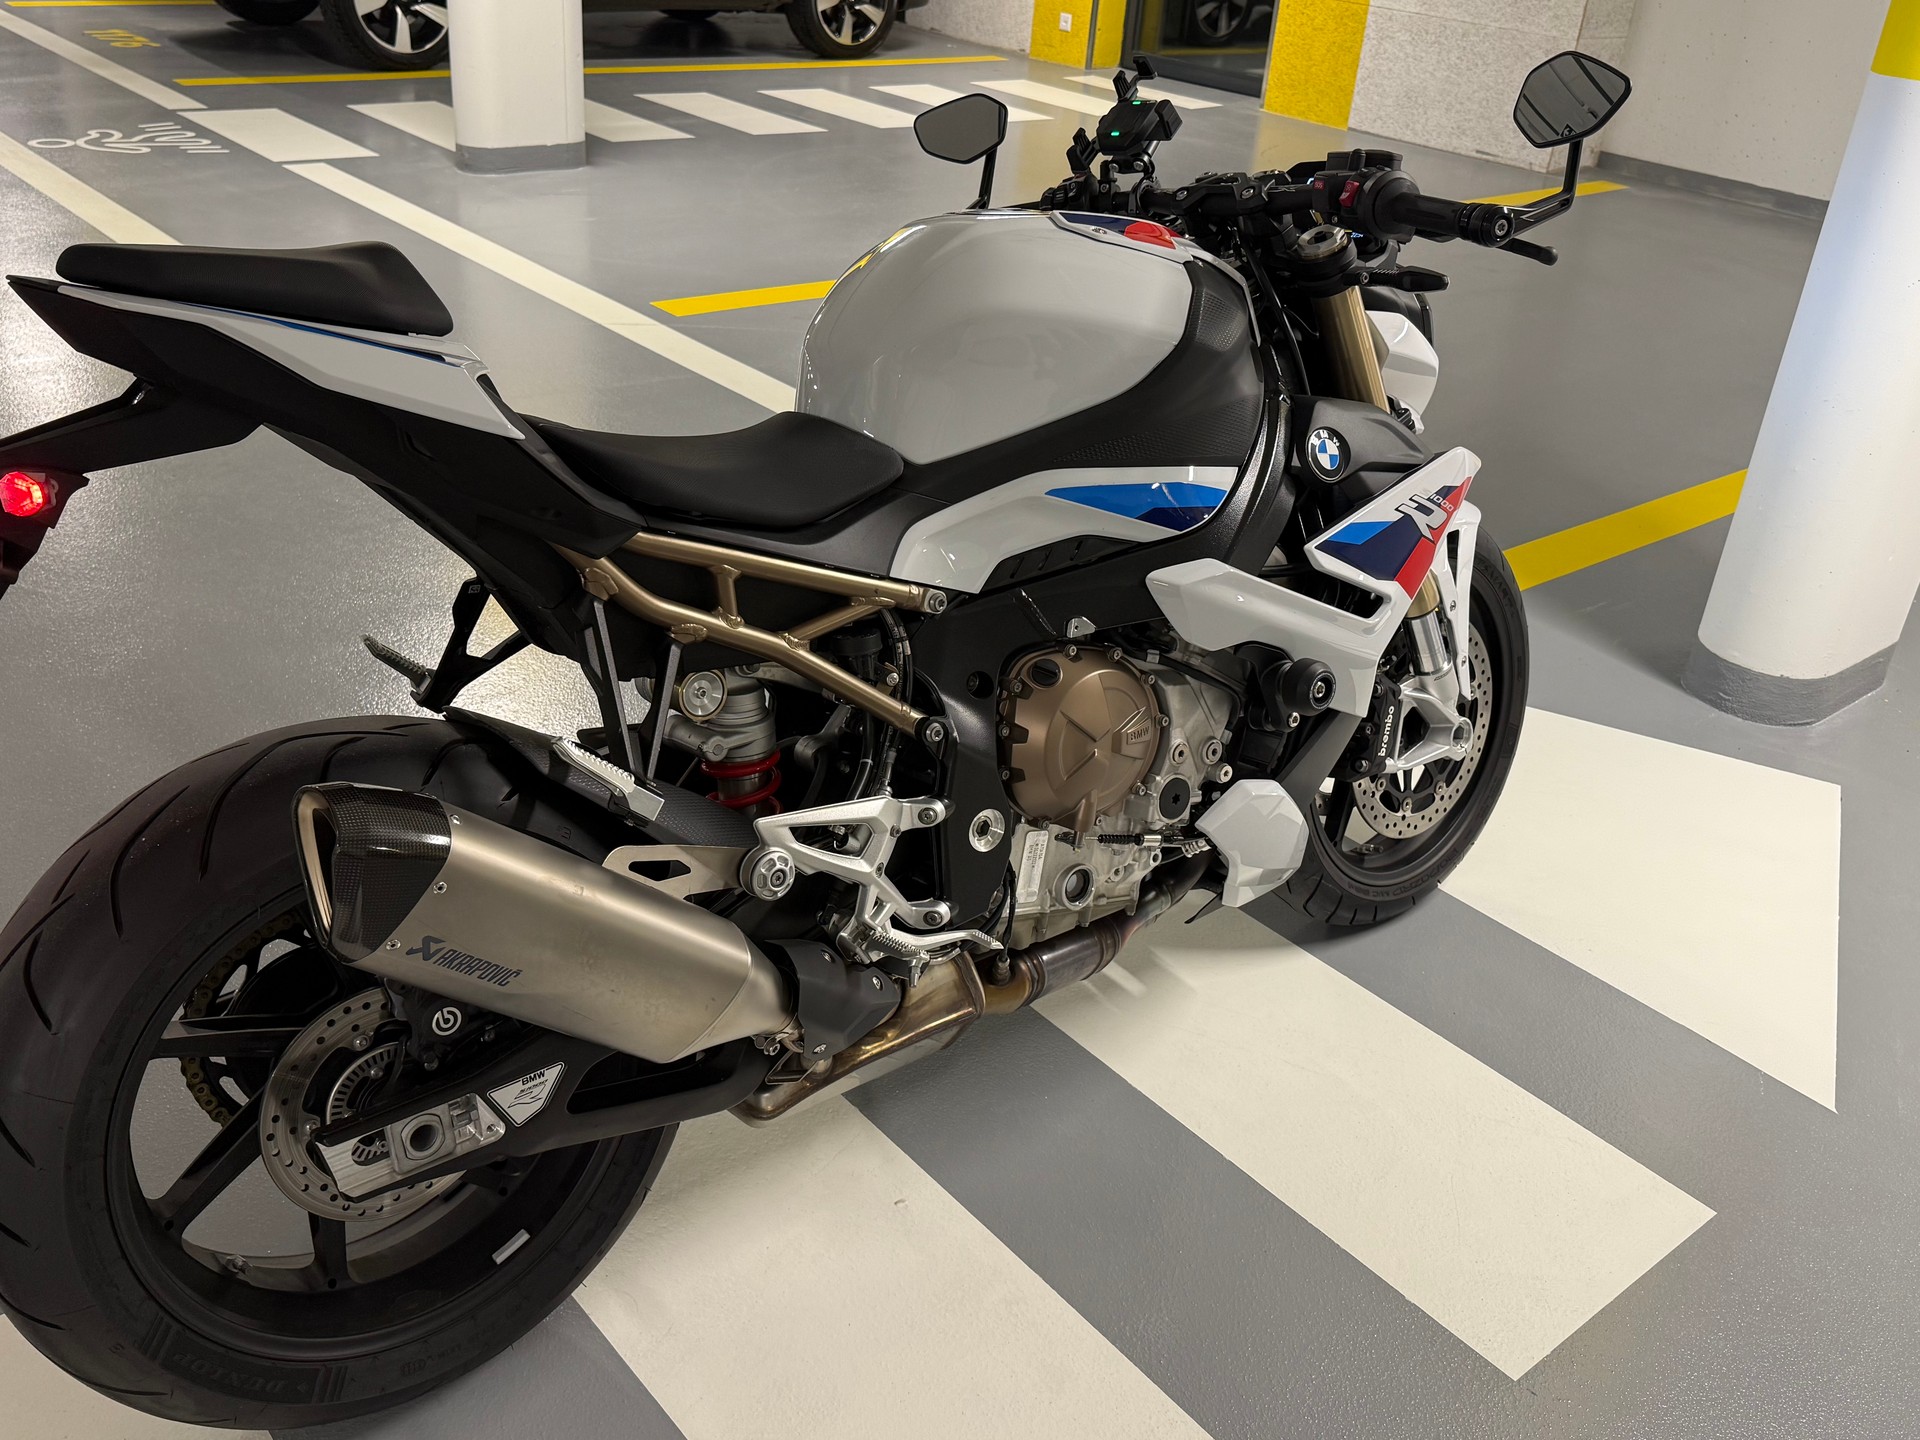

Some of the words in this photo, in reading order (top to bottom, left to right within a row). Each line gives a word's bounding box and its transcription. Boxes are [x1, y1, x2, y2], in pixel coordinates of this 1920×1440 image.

[1309, 429, 1340, 447] BMW
[1429, 493, 1454, 512] 1000
[1130, 725, 1150, 741] BMW
[1377, 705, 1395, 757] brembo
[521, 1069, 546, 1086] BMW
[173, 1352, 286, 1393] DUNLOP
